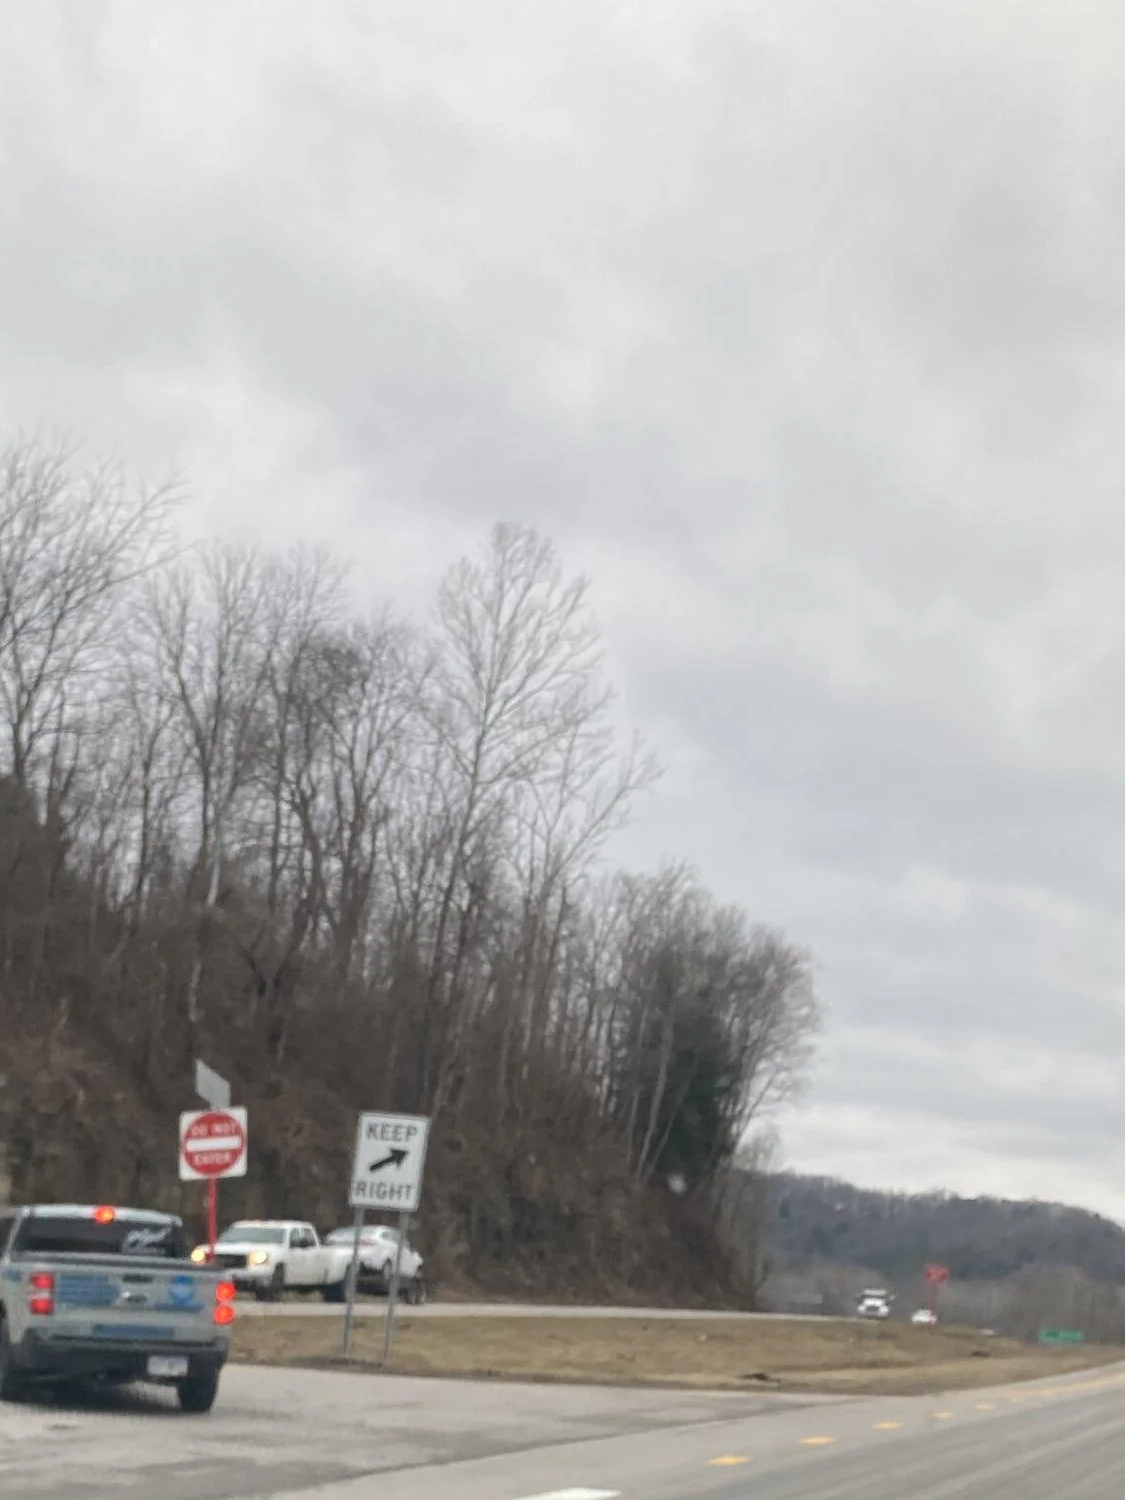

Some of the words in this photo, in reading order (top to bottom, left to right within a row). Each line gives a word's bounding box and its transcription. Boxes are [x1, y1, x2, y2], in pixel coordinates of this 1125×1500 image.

[191, 1124, 208, 1137] DO
[212, 1122, 236, 1135] NOT
[366, 1122, 418, 1142] KEEP
[194, 1151, 233, 1166] ENTER
[354, 1181, 413, 1200] RIGHT
